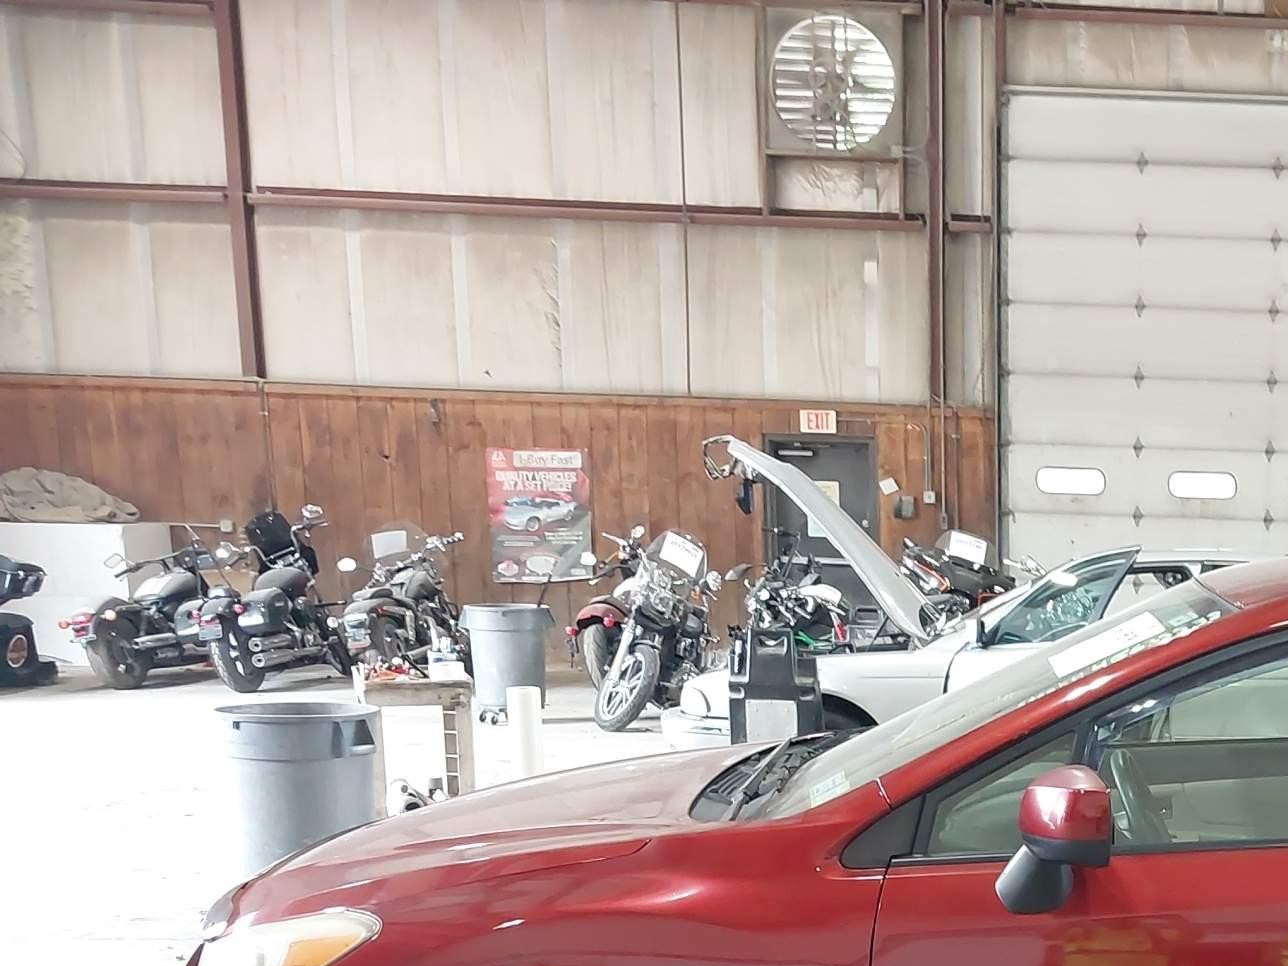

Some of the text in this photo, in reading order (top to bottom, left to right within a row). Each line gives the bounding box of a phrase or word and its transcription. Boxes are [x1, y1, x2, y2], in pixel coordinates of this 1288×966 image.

[807, 412, 831, 430] EXIT
[495, 471, 577, 482] QUALITY VEHICLES
[503, 480, 515, 491] AT
[526, 481, 541, 491] SET
